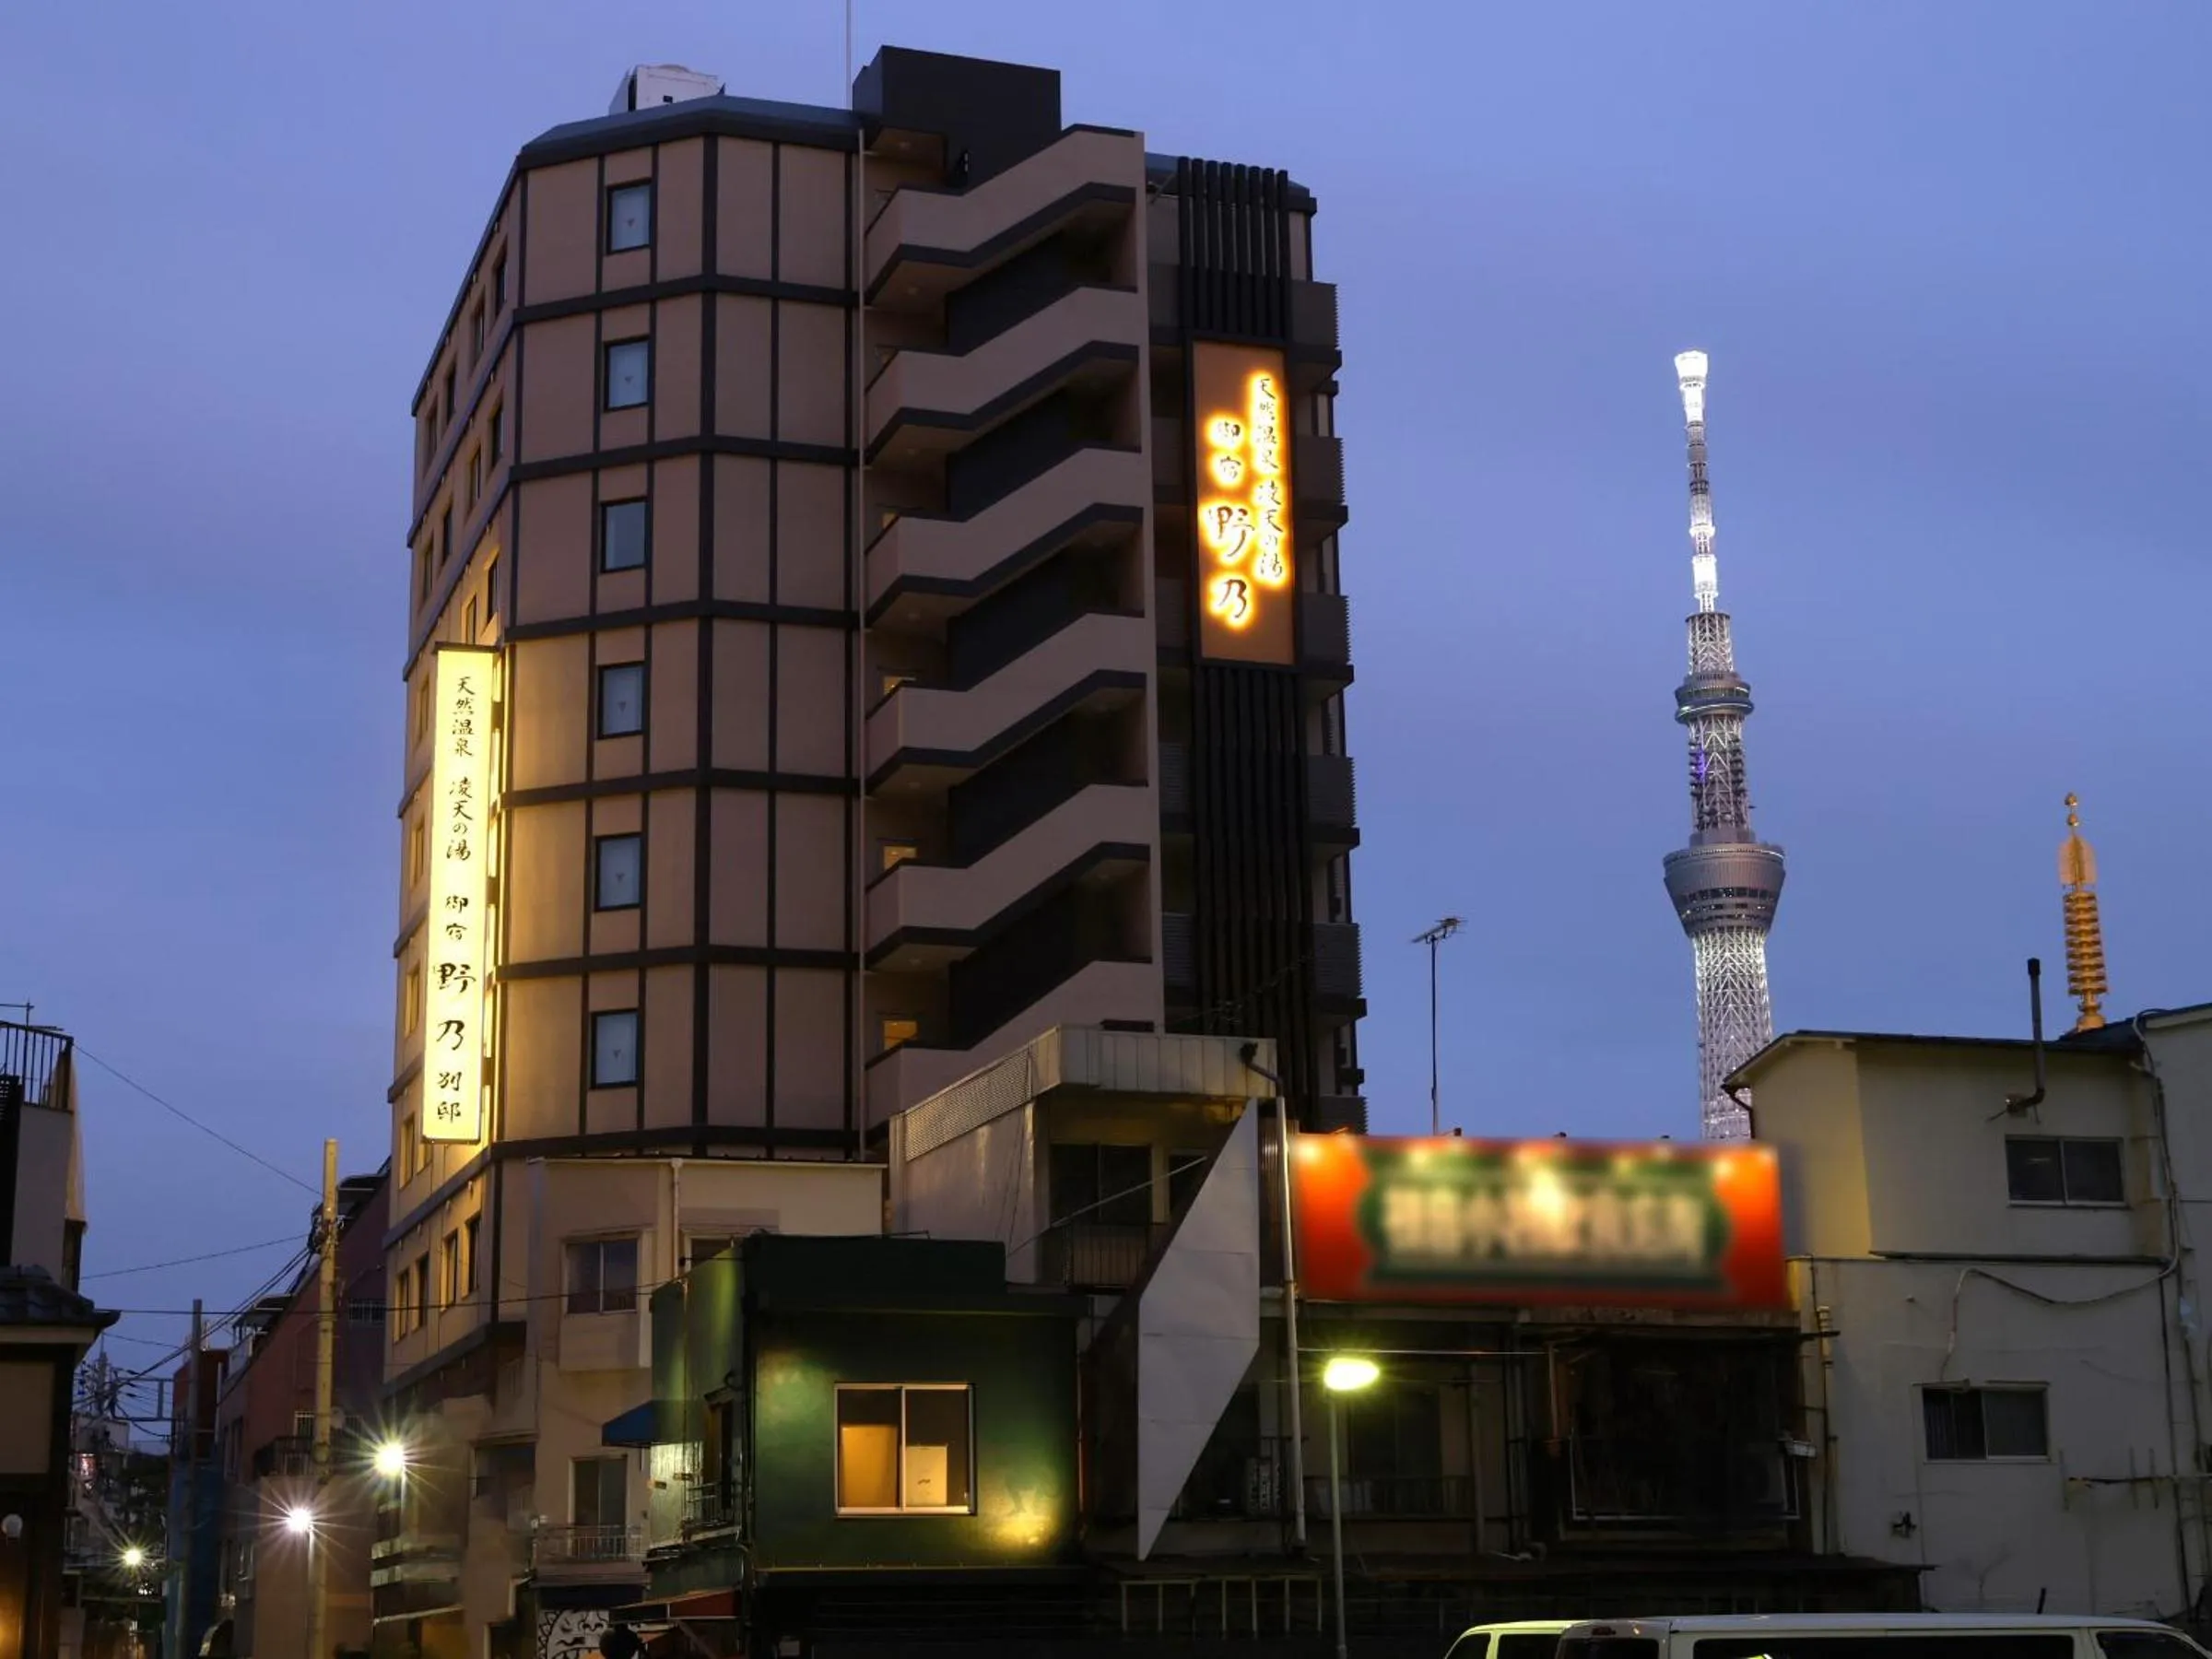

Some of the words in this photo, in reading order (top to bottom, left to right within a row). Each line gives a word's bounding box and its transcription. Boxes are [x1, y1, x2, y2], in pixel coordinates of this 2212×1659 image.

[452, 676, 476, 757] 天然温泉
[446, 777, 474, 861] 凌天の湯
